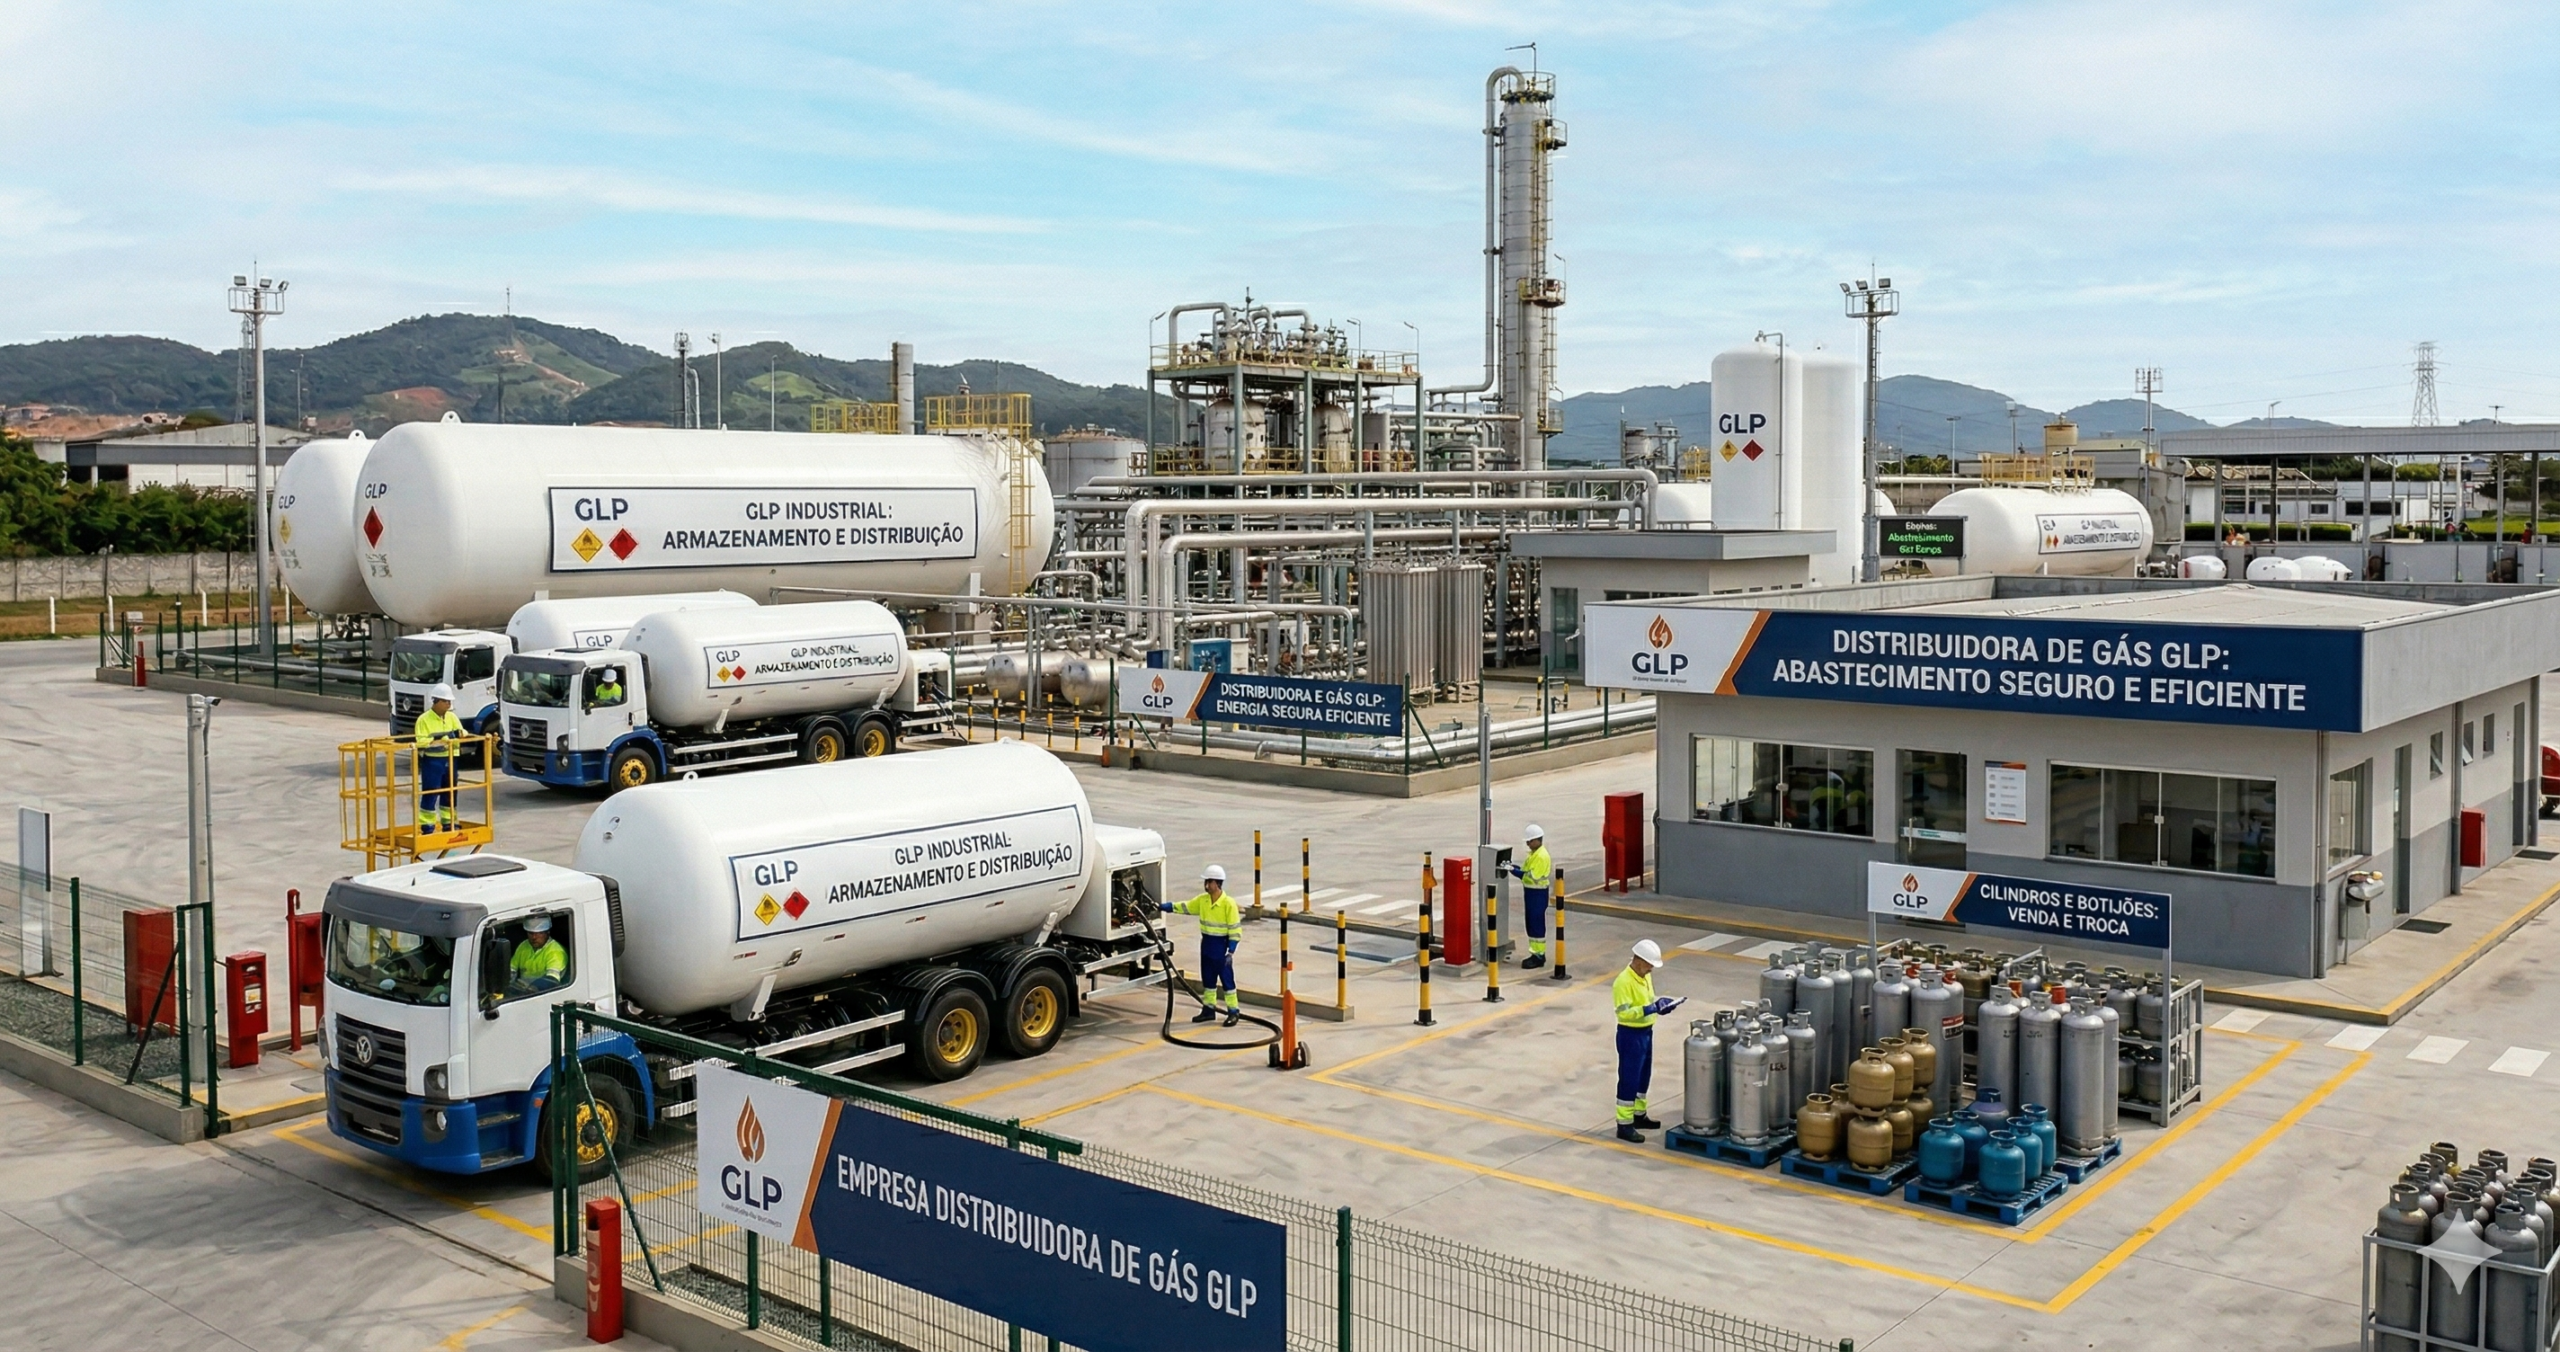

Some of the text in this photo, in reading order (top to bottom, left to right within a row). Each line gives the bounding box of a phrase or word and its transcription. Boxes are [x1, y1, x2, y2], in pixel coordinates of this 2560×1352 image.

[1719, 413, 1766, 434] GLP
[365, 483, 387, 499] GLP
[574, 498, 628, 521] GLP
[746, 502, 892, 520] GLP INDUSTRIAL:
[662, 523, 963, 549] ARMAZENAMENTO E DISTRIBUIÇÃO
[586, 635, 613, 647] GLP
[1833, 630, 2229, 671] DISTRIBUIDORA DE GÁS GLP:
[716, 650, 740, 663] GLP
[1632, 652, 1688, 675] GLP
[1221, 682, 1385, 708] DISTRIBUIDORA E GÁS GLP:
[1773, 659, 2306, 711] ABASTECIMENTO SEGURO E EFICIENTE
[1143, 695, 1173, 709] GLP
[1217, 700, 1391, 727] ENERGIA SEGURA EFICIENTE
[895, 845, 923, 865] GLP
[754, 860, 798, 886] GLP
[828, 843, 1072, 904] ARMAZENAMENTO E DISTRIBUIÇÃO
[1893, 893, 1928, 908] GLP
[1980, 884, 2159, 919] CILINDROS E BOTIJÕES:
[2007, 906, 2130, 936] VENDA E TROCA
[721, 1165, 782, 1211] GLP
[837, 1154, 930, 1217] EMPRESA
[936, 1185, 1104, 1273] DISTRIBUIDORA
[1111, 1239, 1141, 1285] DE
[1149, 1249, 1199, 1302] GÁS
[1207, 1269, 1257, 1319] GLP
